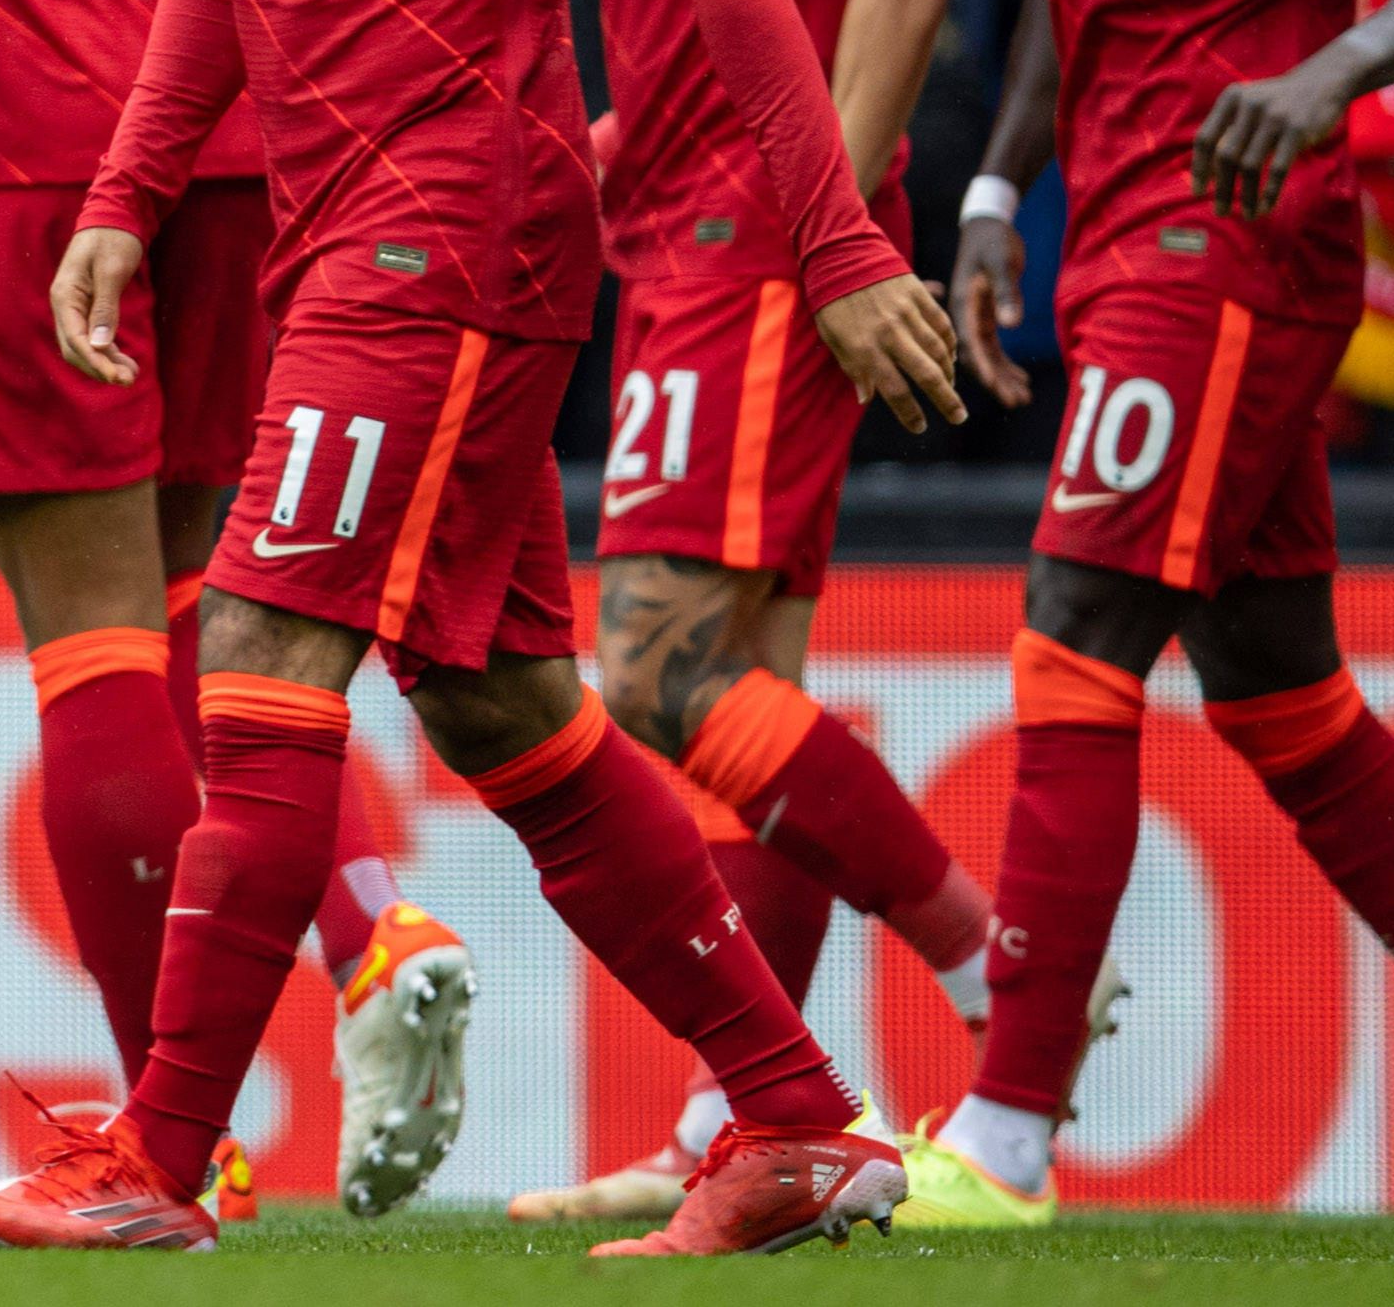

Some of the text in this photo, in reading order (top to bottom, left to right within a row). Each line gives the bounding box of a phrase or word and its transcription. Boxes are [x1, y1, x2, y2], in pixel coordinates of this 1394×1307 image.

[270, 405, 388, 539] 11
[604, 369, 699, 483] 21
[1059, 365, 1175, 493] 10
